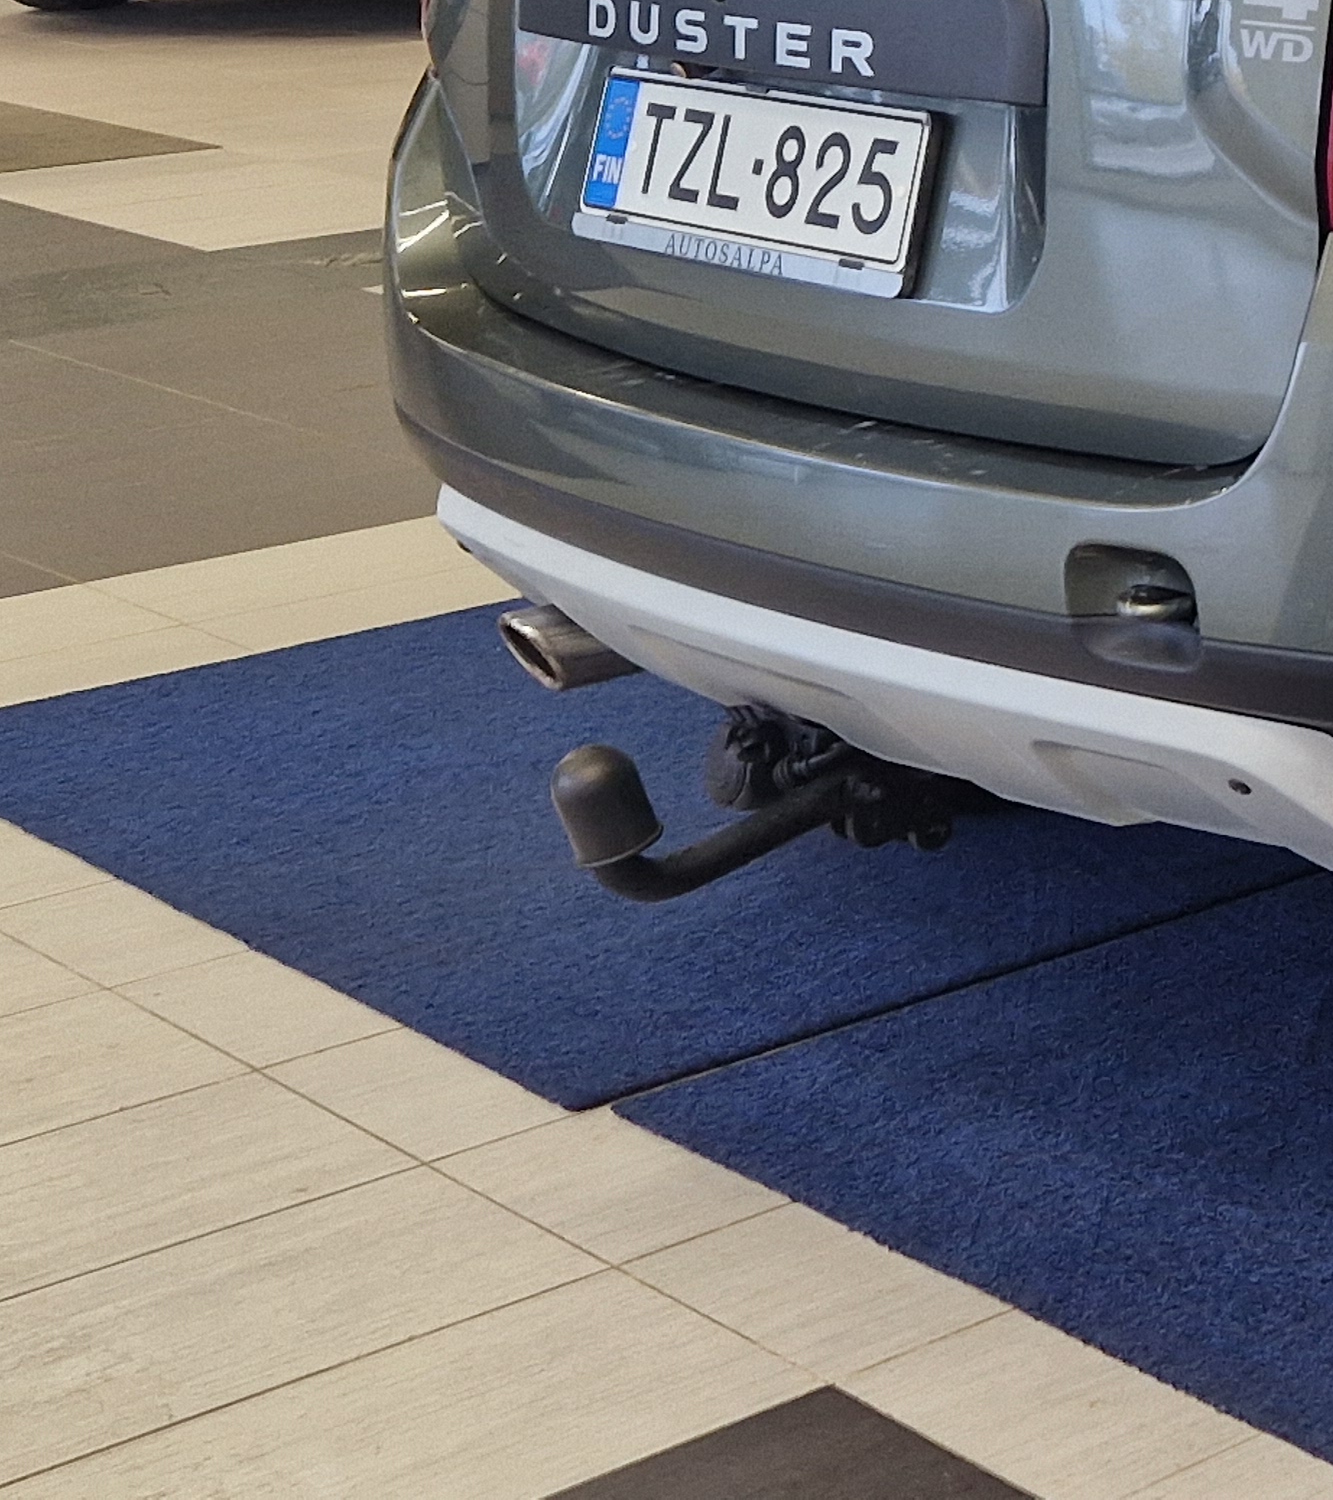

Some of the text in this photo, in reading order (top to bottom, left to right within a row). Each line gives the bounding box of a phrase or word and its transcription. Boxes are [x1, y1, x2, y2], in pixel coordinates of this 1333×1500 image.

[591, 153, 623, 184] FIN
[641, 102, 900, 236] TZL-825
[664, 232, 784, 276] AUTOSALPA
